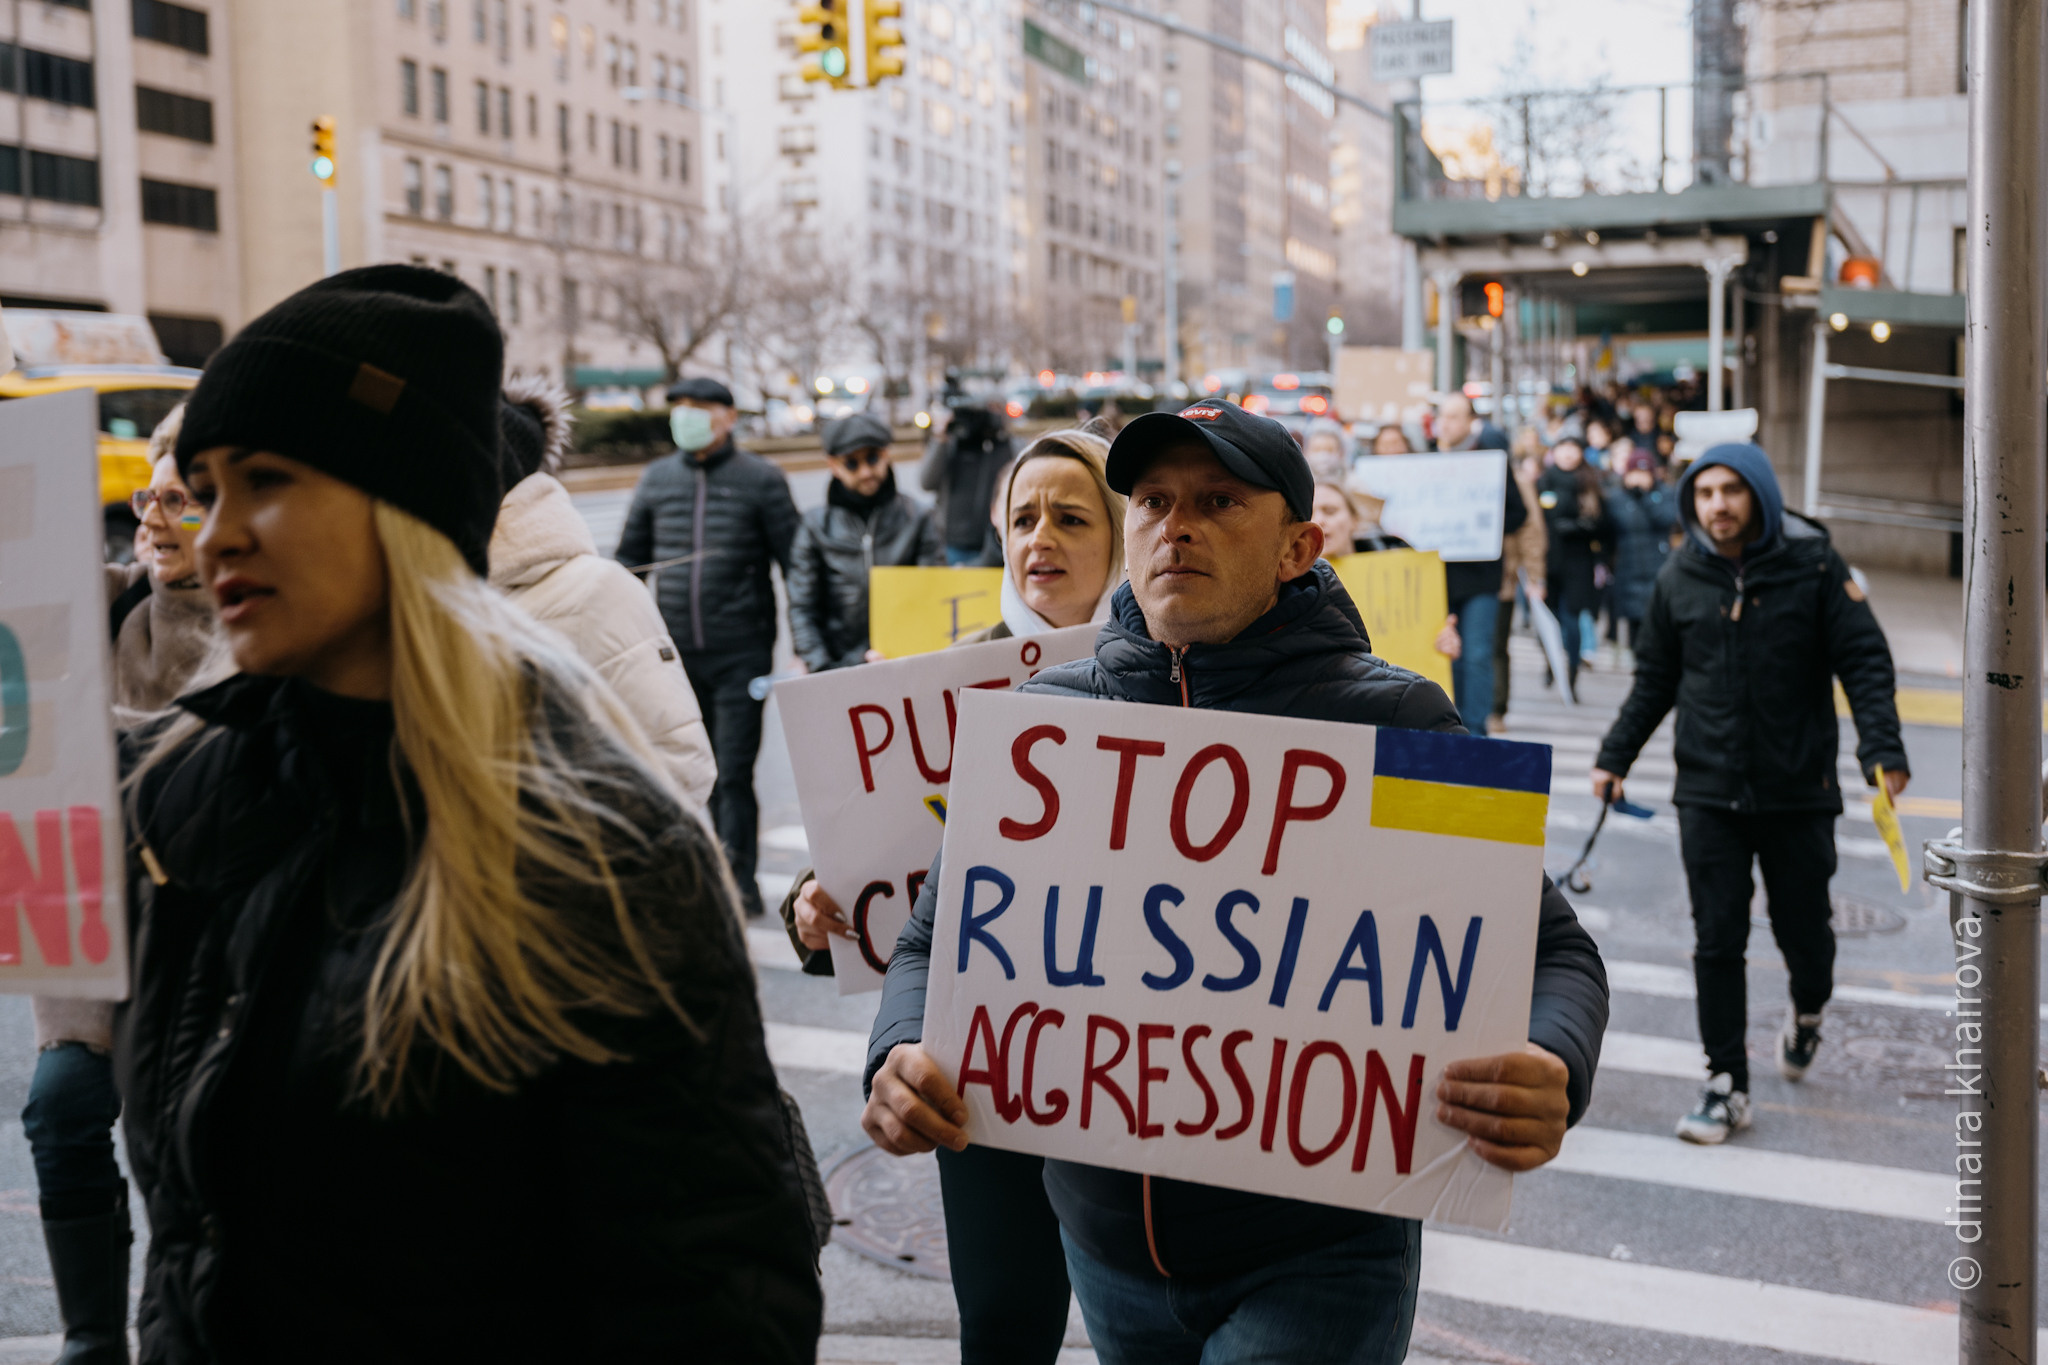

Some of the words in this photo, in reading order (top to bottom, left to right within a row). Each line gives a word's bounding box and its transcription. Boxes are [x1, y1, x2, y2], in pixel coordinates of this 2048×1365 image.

[998, 724, 1347, 876] STOP
[957, 865, 1483, 1033] RUSSIAN
[957, 1002, 1425, 1176] AGGRESSION
